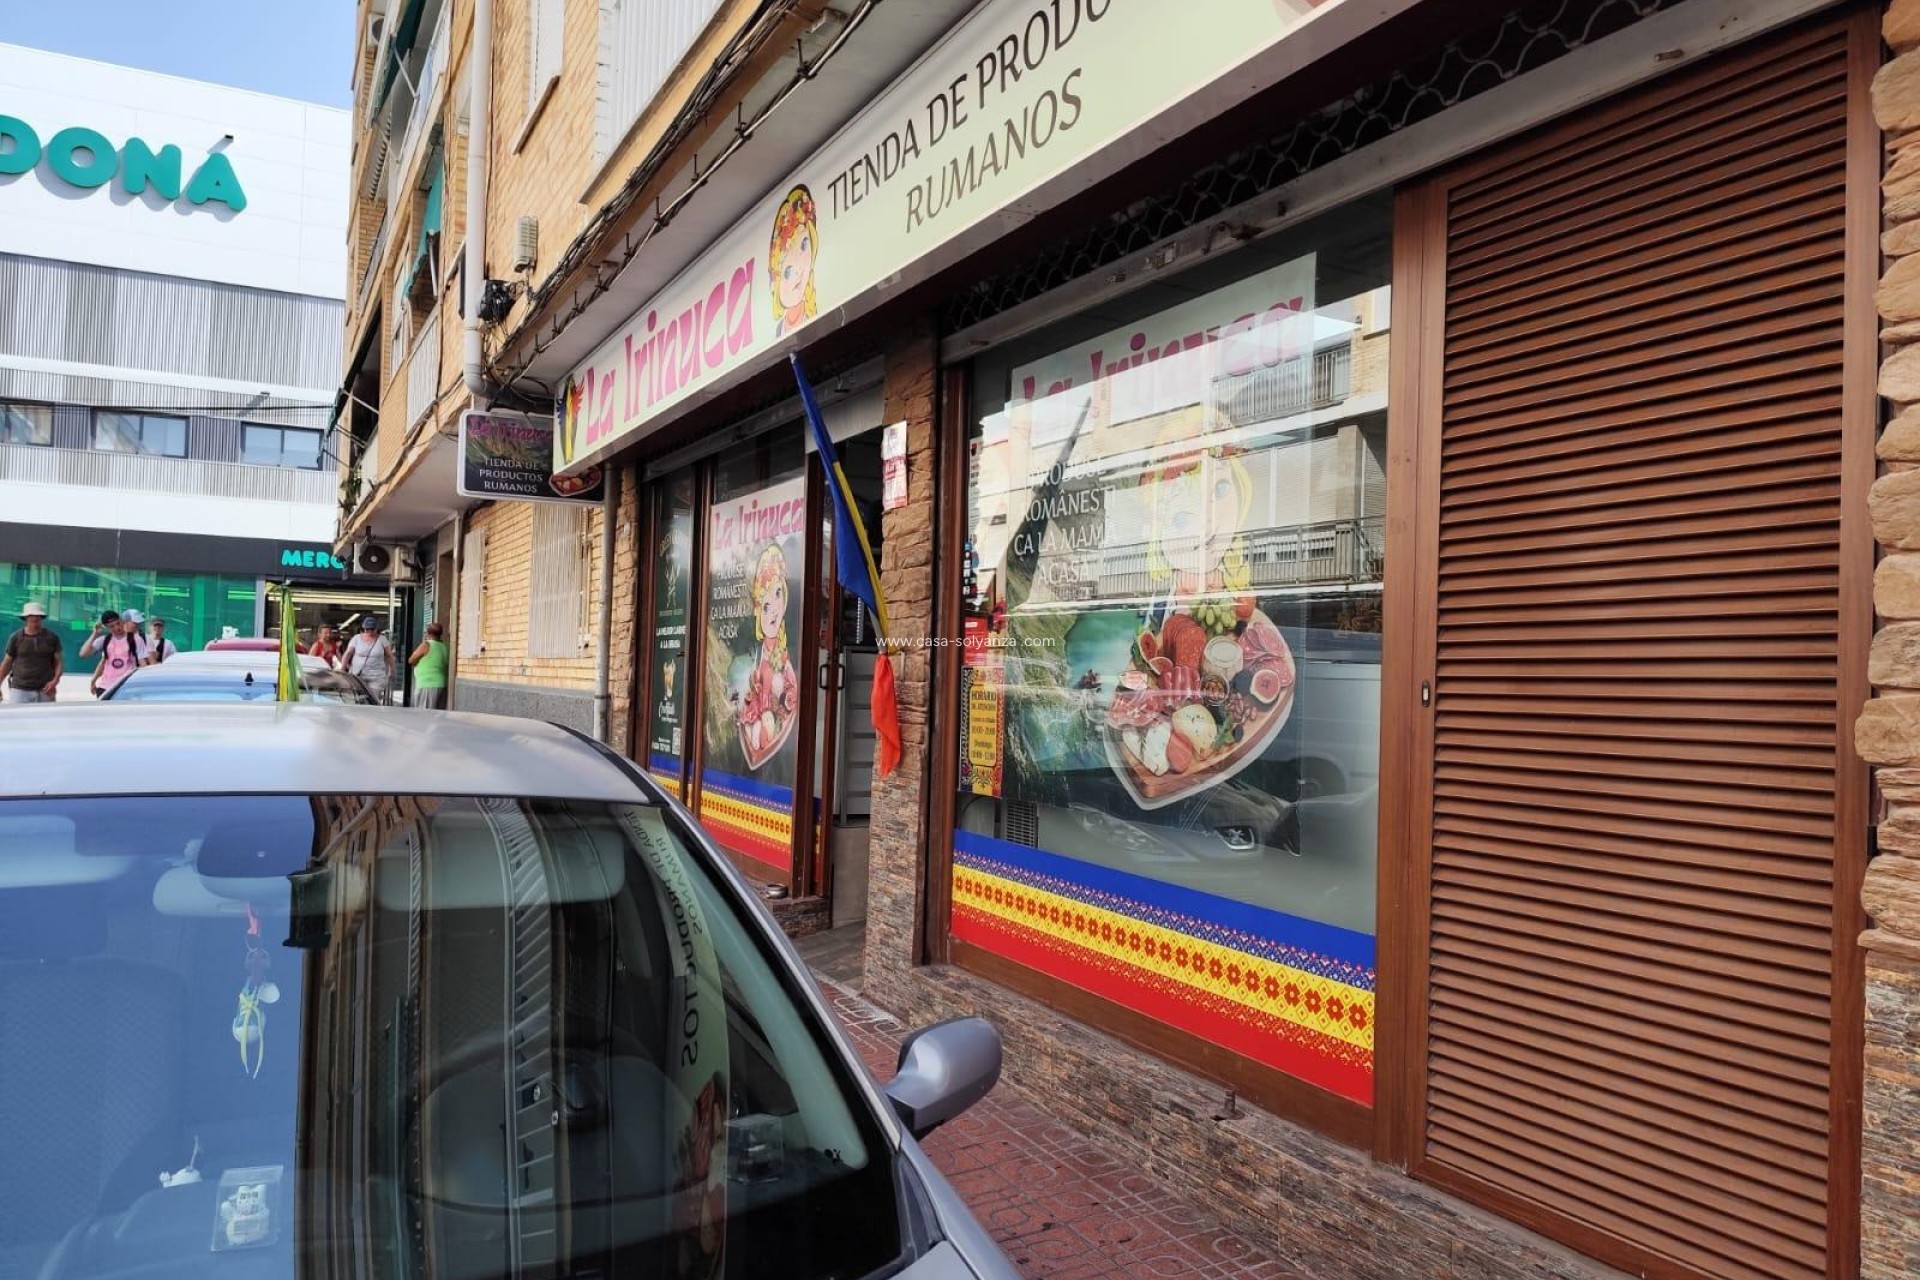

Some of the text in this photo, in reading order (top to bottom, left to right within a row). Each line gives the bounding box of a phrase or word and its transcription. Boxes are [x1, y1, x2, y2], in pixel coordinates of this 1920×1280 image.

[827, 118, 921, 219] TIENDA
[926, 73, 968, 147] DE
[905, 67, 1082, 234] RUMANOS
[585, 256, 756, 446] La Irinuca
[479, 469, 543, 483] PRODUCTOS
[484, 457, 523, 469] TIENDA
[484, 480, 538, 493] RUMANOS
[1024, 484, 1117, 522] OMÂNESTI
[1037, 531, 1058, 553] LA
